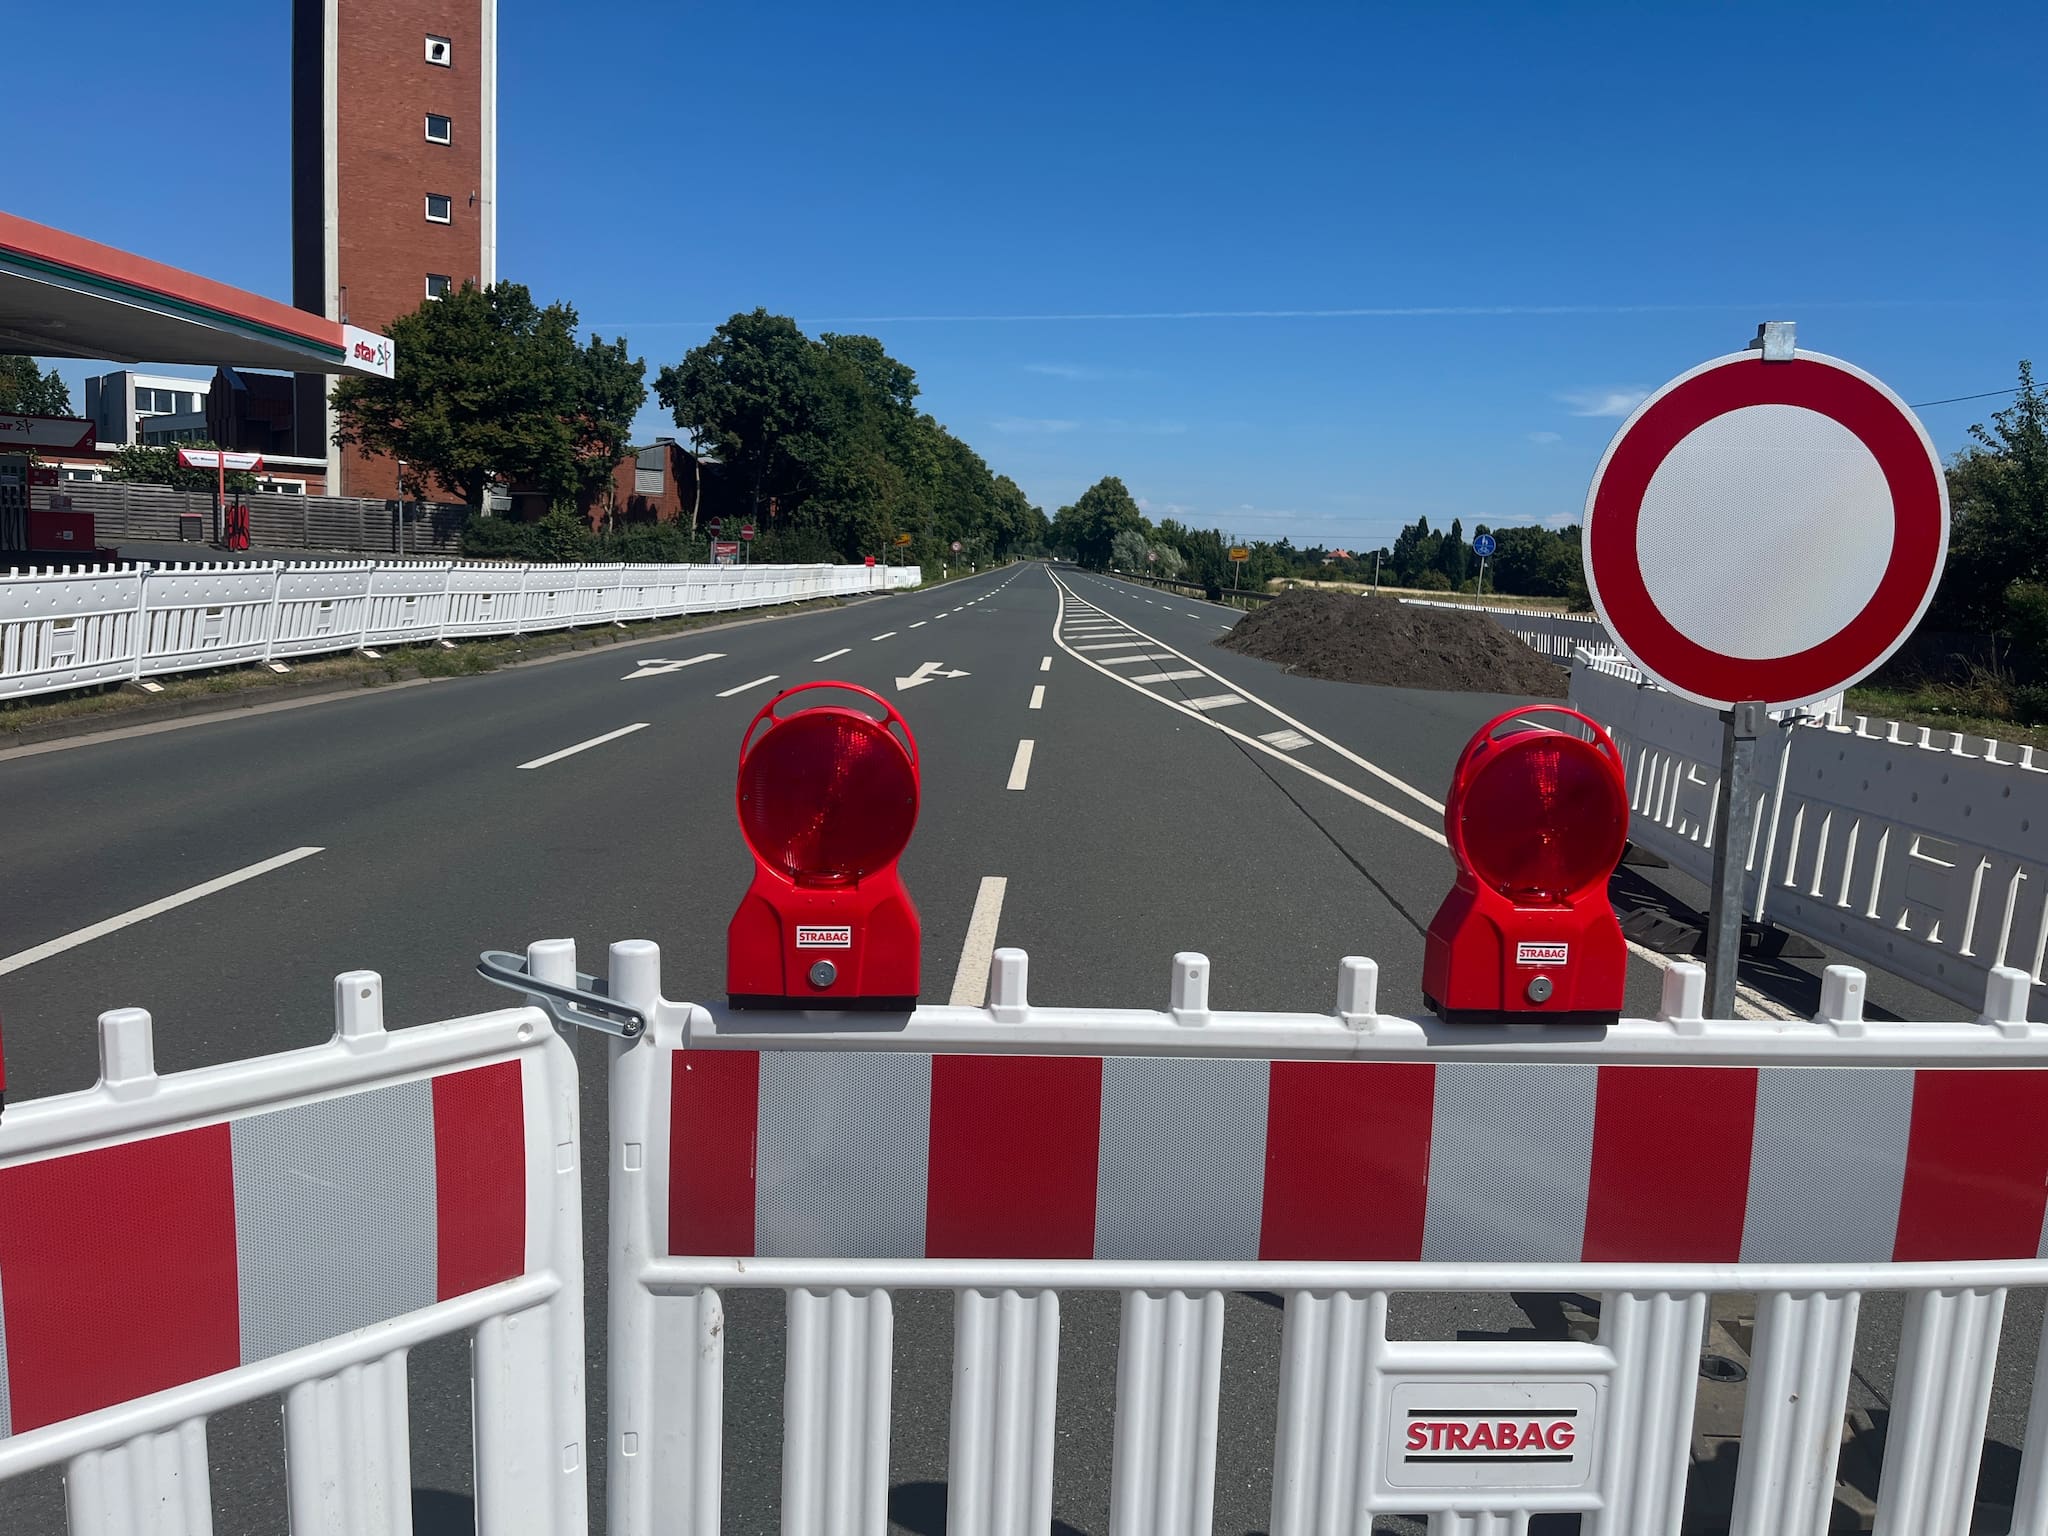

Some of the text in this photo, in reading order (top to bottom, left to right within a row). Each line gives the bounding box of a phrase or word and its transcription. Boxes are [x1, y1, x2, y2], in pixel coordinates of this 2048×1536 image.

[354, 341, 376, 363] star
[0, 422, 14, 430] ar
[86, 438, 93, 446] 2
[799, 932, 849, 942] STRABAG
[1519, 949, 1566, 958] STRABAG
[1405, 1421, 1576, 1451] STRABAG
